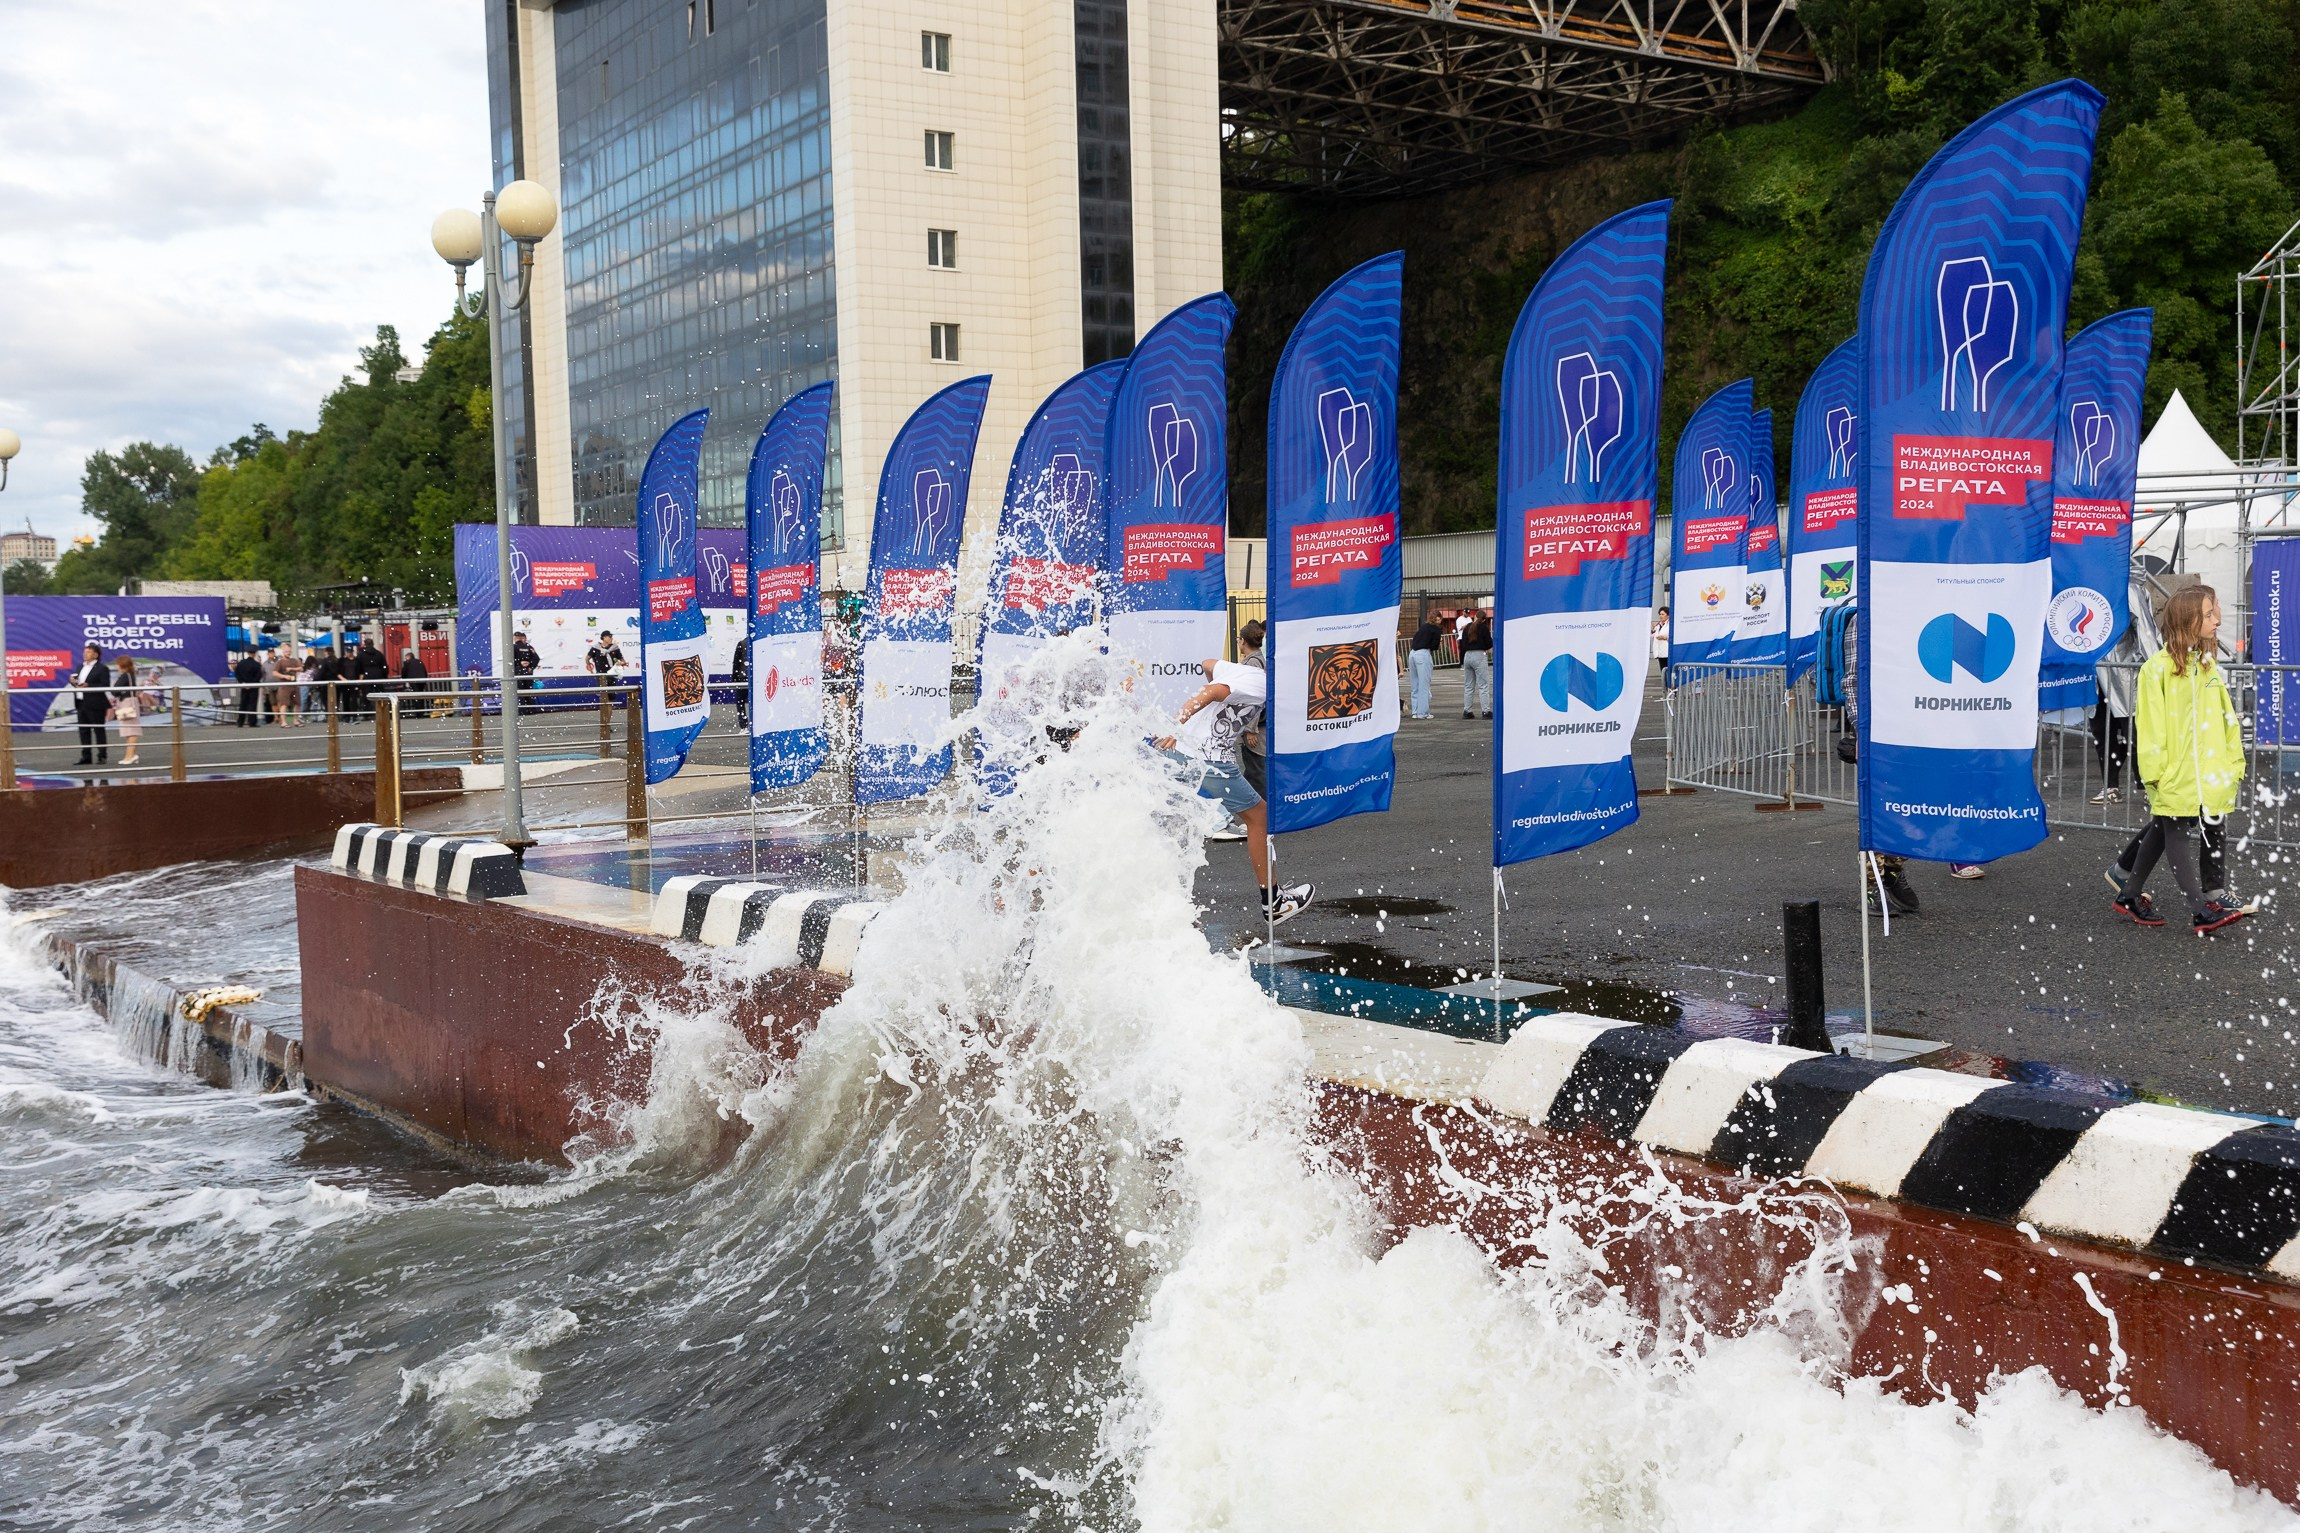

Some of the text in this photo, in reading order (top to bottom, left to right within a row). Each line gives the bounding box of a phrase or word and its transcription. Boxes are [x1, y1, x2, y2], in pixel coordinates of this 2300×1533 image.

[1900, 446, 2031, 461] МЕЖДУНАРОДНАЯ
[1900, 459, 2043, 475] ВЛАДИВОСТОКСКАЯ
[1899, 477, 2007, 495] РЕГАТА
[1900, 499, 1935, 510] 2024
[2054, 503, 2121, 512] ЕЖДУНАРОДНАЯ
[1530, 511, 1633, 528] МЕЖДУНАРОДНАЯ
[1807, 507, 1856, 521] РЕГАТА
[2053, 510, 2127, 520] ЛАДИВОСТОКСКАЯ
[1530, 521, 1642, 539] ВЛАДИВОСТОКСКАЯ
[1688, 520, 1739, 530] МЕЖДУНАРОДНАЯ
[1688, 525, 1743, 535] ВЛАДИВОСТОКСКАЯ
[1806, 521, 1823, 529] 2024
[1128, 532, 1208, 541] МЕЖДУНАРОДНАЯ
[1296, 524, 1384, 542] МЕЖДУНАРОДНАЯ
[1687, 533, 1729, 544] РЕГАТА
[2051, 531, 2066, 539] 024
[1128, 541, 1216, 550] ВЛАДИВОСТОКСКАЯ
[1296, 532, 1390, 552] ВЛАДИВОСТОКСКАЯ
[1529, 539, 1612, 558] РЕГАТА
[1127, 552, 1193, 565] РЕГАТА
[1295, 550, 1369, 568] РЕГАТА
[1529, 560, 1555, 572] 2024
[1127, 568, 1149, 577] 2024
[1296, 571, 1319, 581] 2024
[535, 578, 577, 586] РЕГАТА
[1937, 577, 1976, 585] ТИТУЛЬНЫЙ
[652, 599, 680, 609] РЕГАТА
[134, 614, 212, 626] ГРЕБЕЦ
[1743, 612, 1770, 621] МИНСПОРТ
[2049, 589, 2111, 642] ОЛИМПИЙСКИЙ КОМИТЕТ РОССИИ
[1746, 619, 1768, 627] РОССИИ
[83, 626, 166, 638] СВОЕГО
[6, 668, 47, 678] ЕГАТА
[1151, 662, 1204, 676] ПОЛЮ
[1914, 696, 2013, 711] НОРНИКЕЛЬ
[1538, 720, 1621, 737] НОРНИКЕЛЬ
[1284, 771, 1390, 804] regatavladivostok.ru
[1512, 801, 1633, 829] regatavladivostok.ru
[1884, 801, 2039, 821] regatavladivostok.ru
